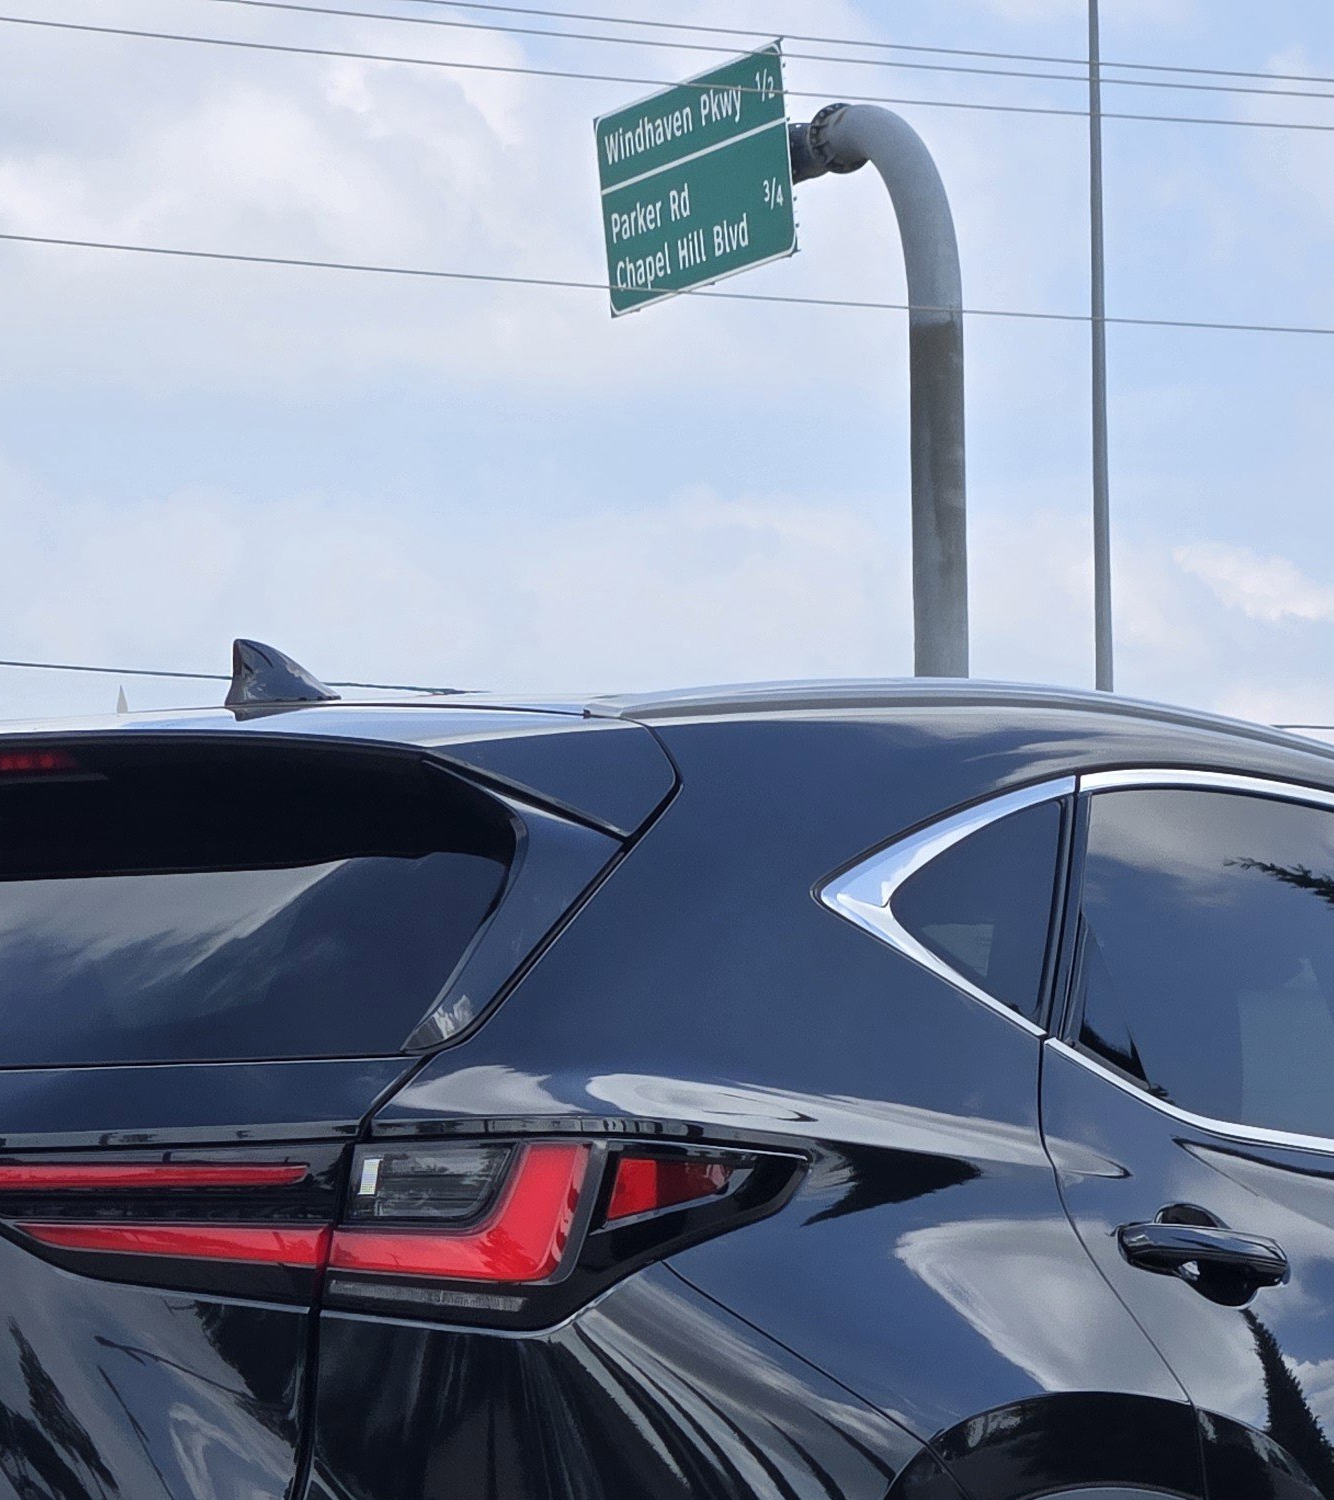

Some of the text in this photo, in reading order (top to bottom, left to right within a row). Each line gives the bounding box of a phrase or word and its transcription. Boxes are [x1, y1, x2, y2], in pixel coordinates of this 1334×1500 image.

[604, 68, 775, 166] Windhaven Pkwy 1/2
[611, 177, 784, 244] Parker Rd 3/4
[616, 213, 749, 291] Chapel Hill Blvd
